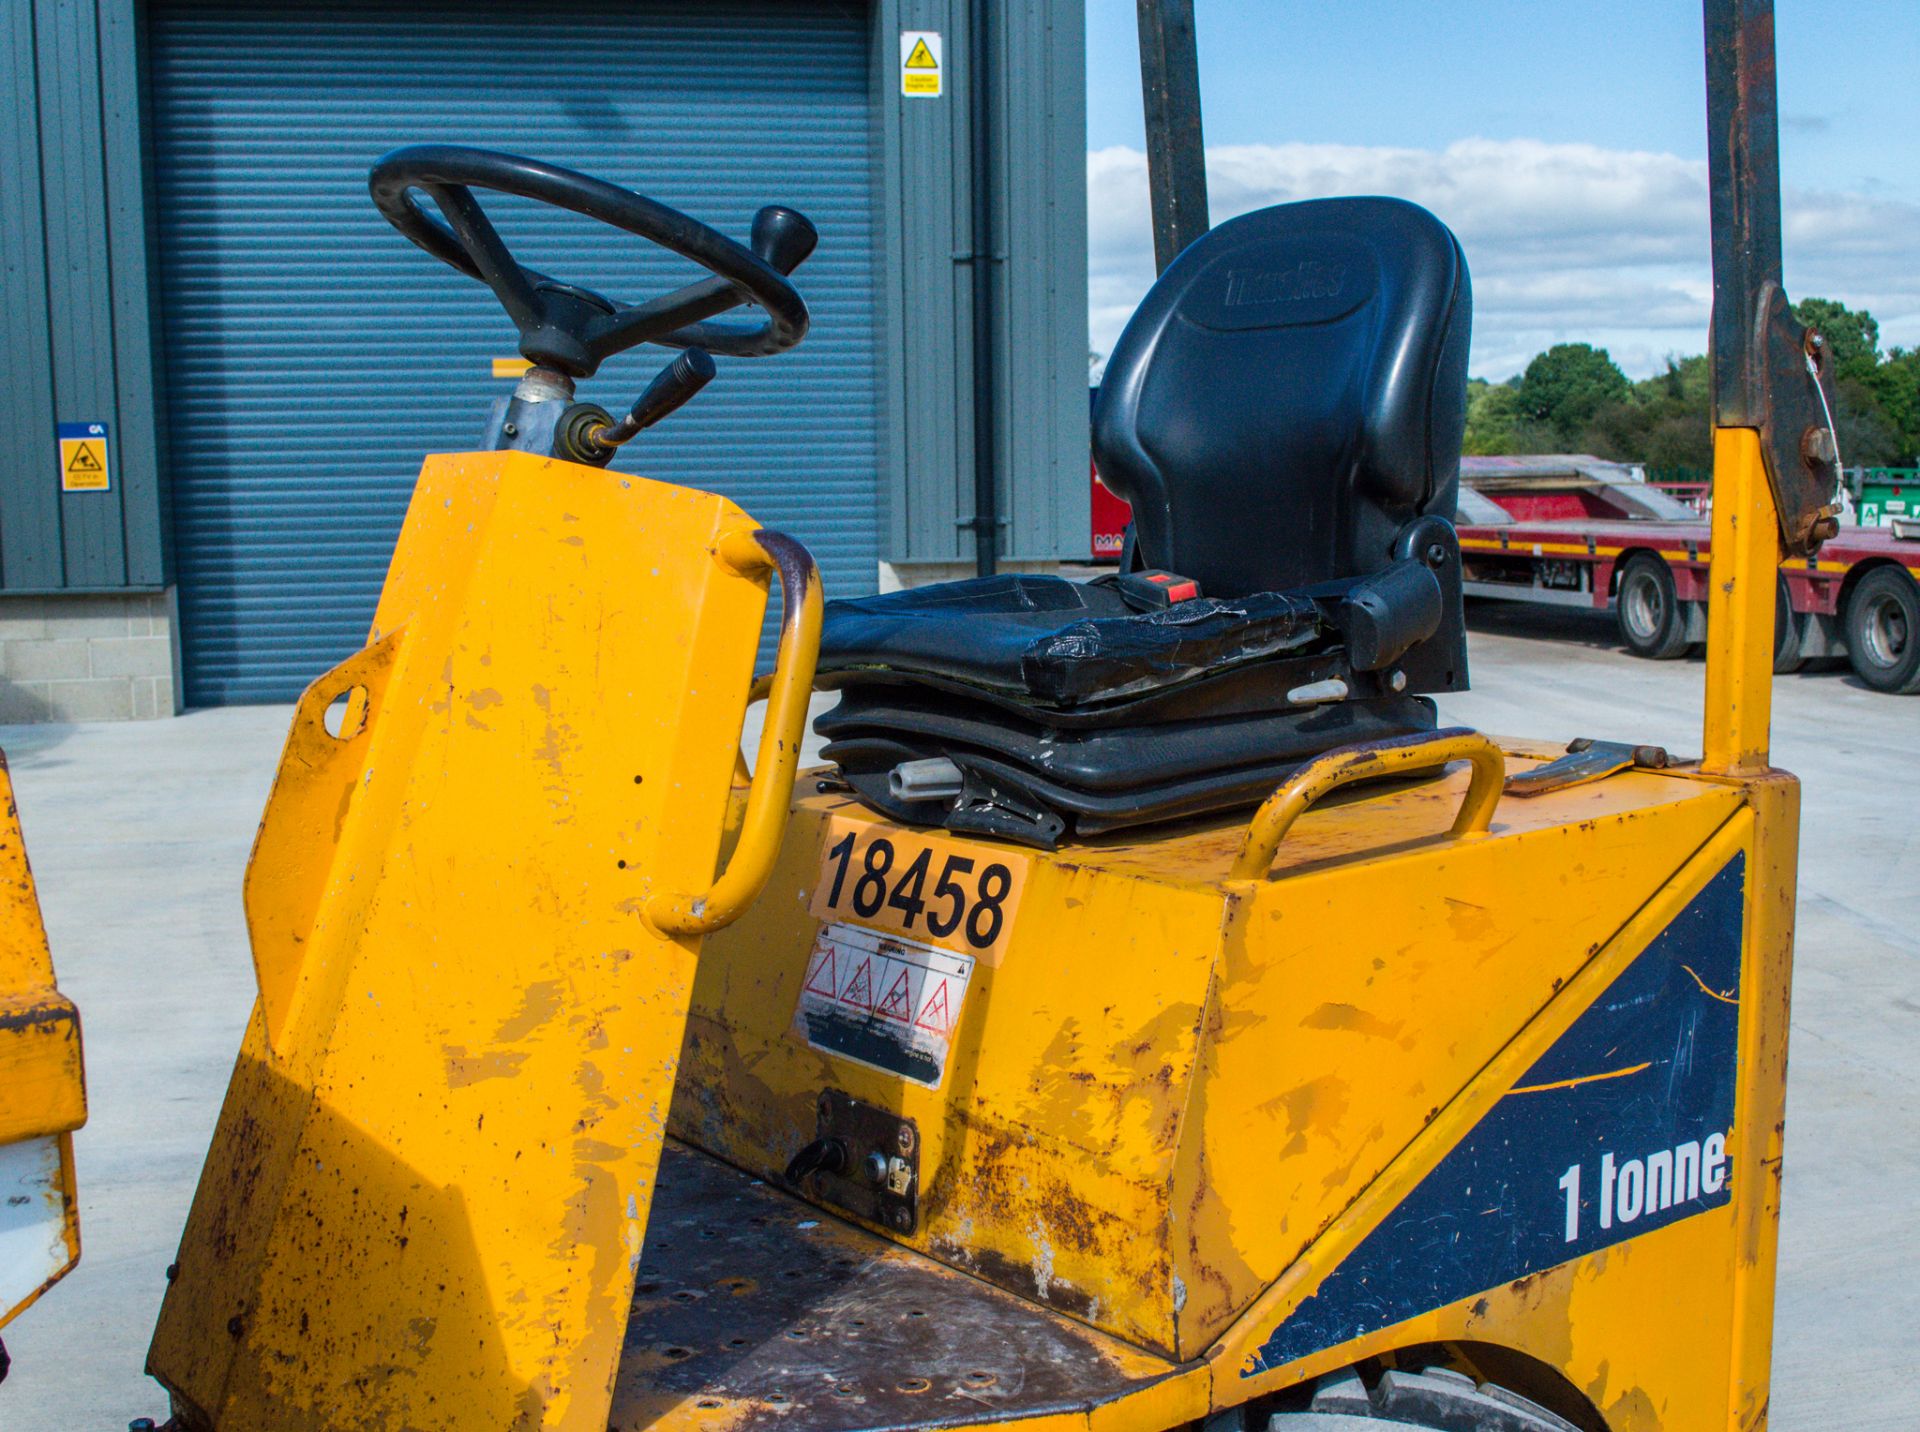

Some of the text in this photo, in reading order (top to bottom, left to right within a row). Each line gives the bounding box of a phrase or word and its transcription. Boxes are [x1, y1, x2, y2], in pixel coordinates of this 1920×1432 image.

[829, 832, 1012, 949] 18458
[1559, 1132, 1726, 1243] 1 tonne
